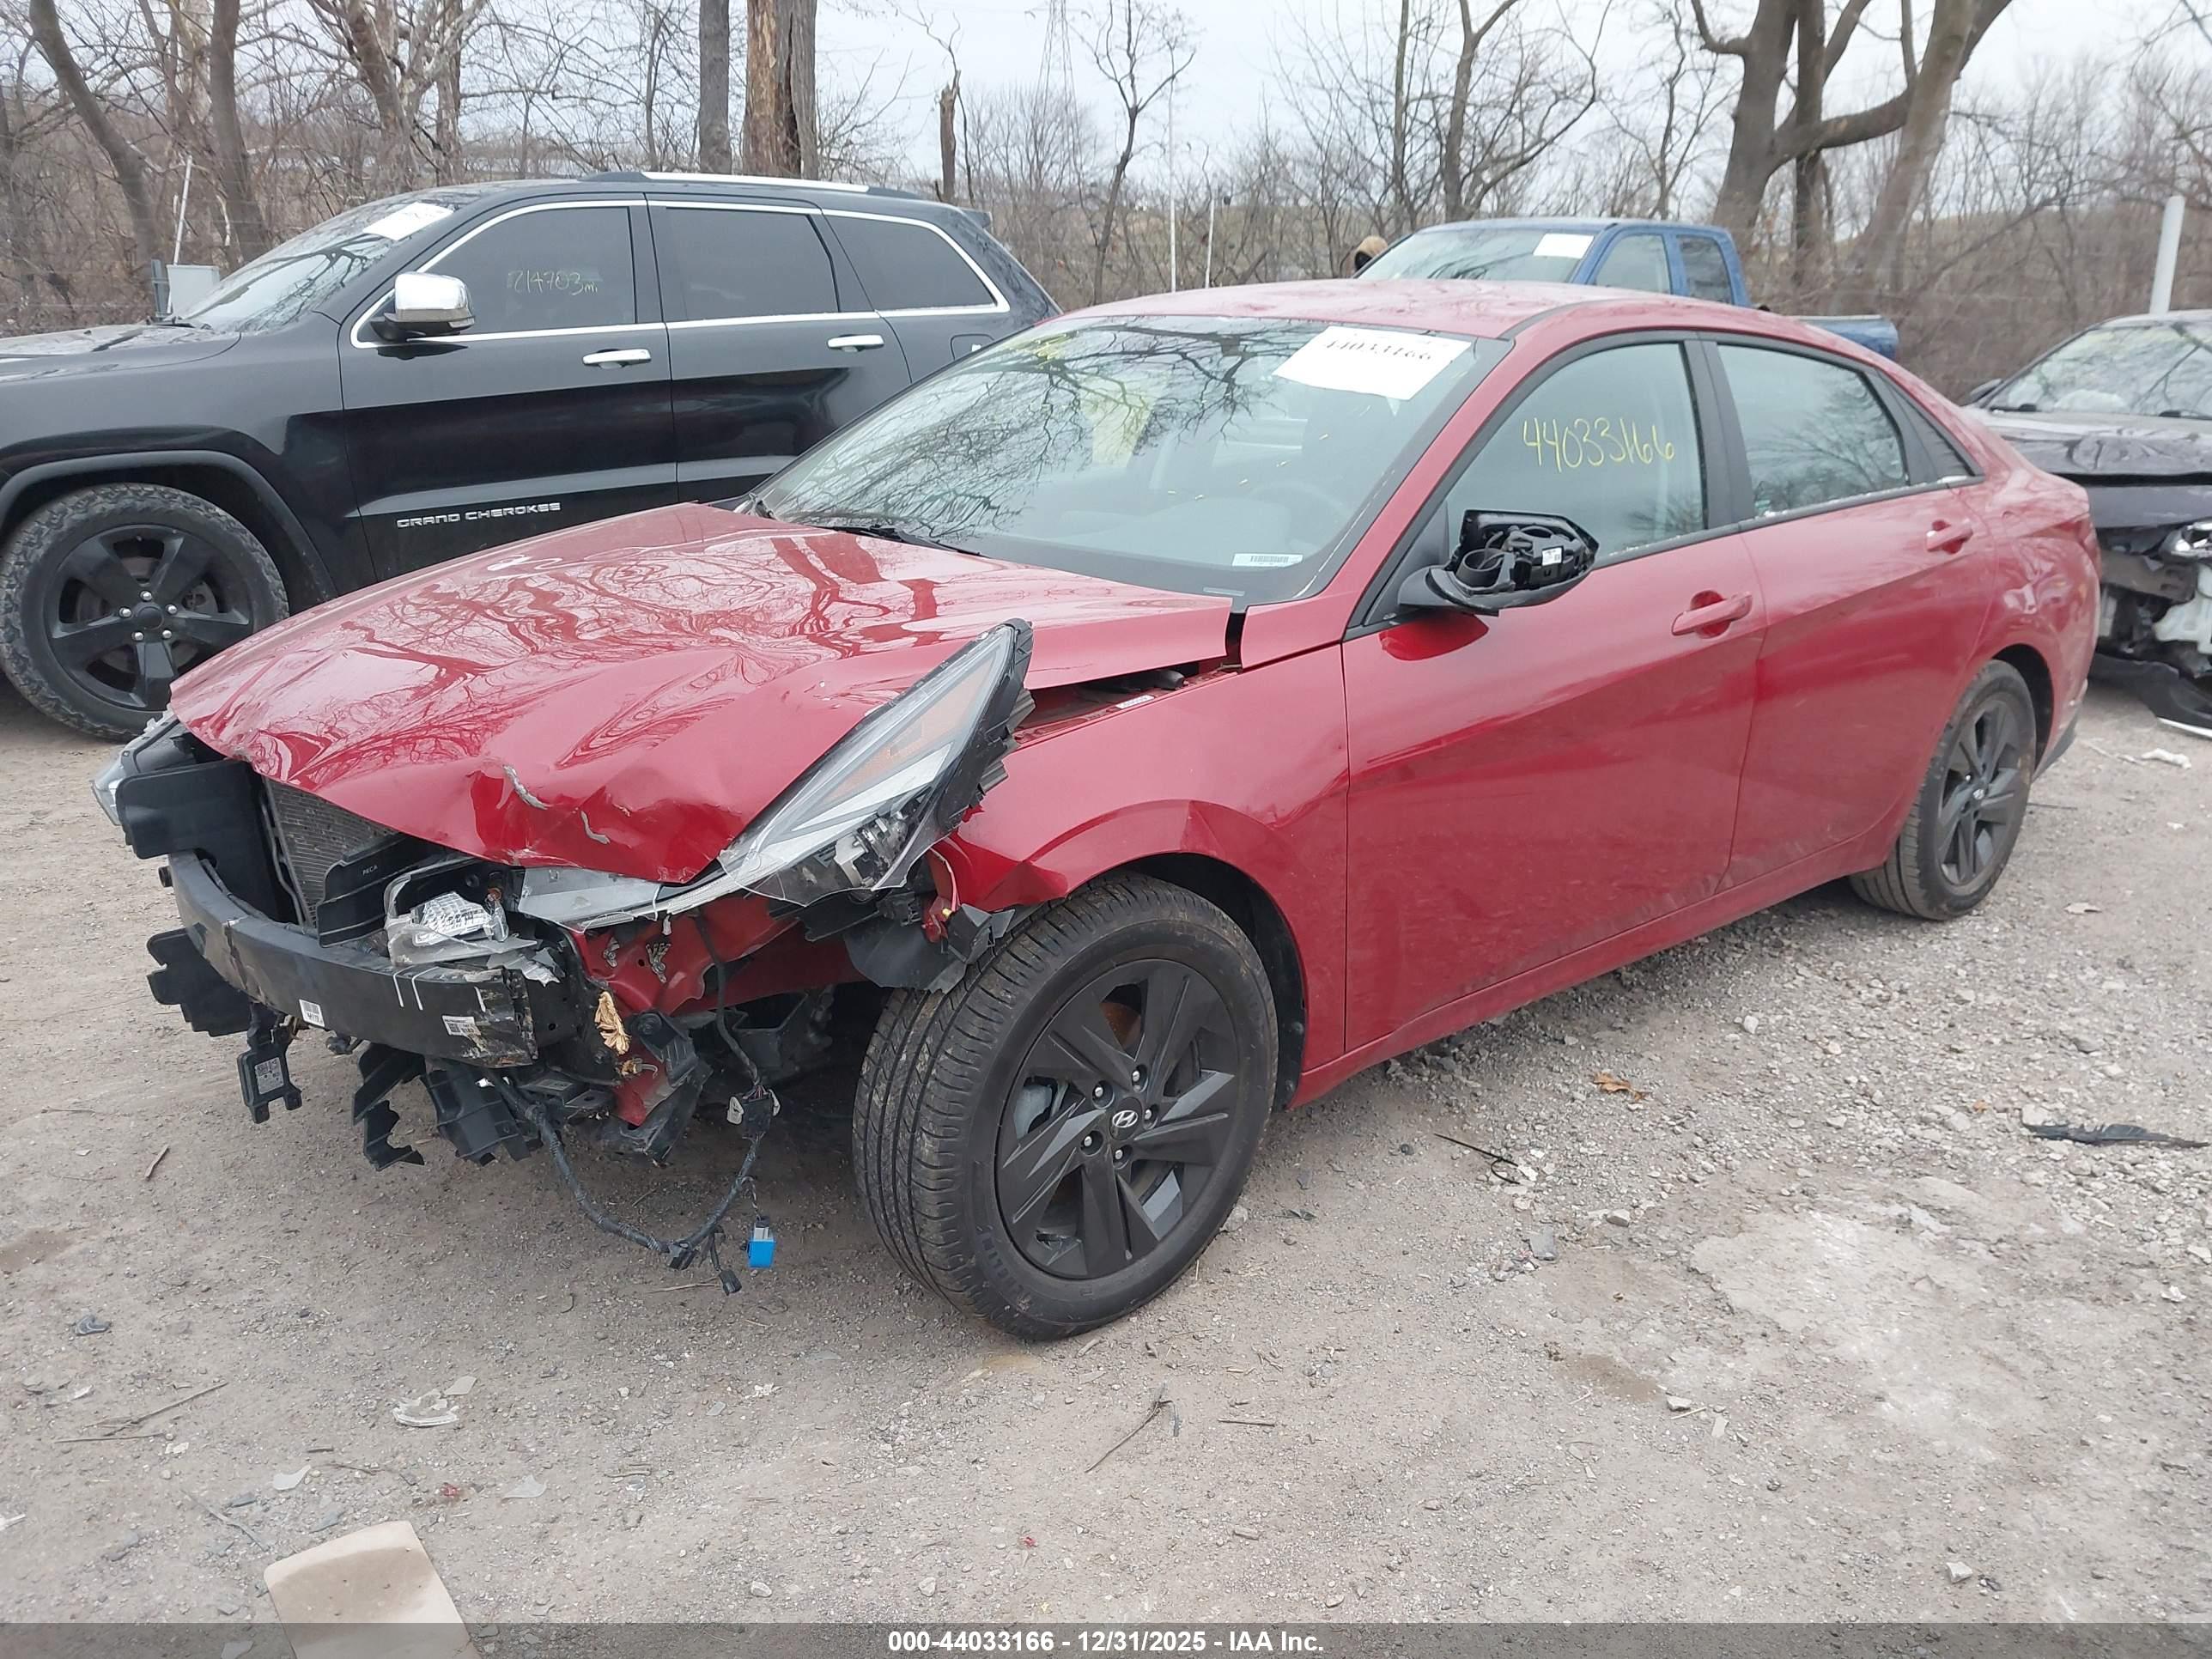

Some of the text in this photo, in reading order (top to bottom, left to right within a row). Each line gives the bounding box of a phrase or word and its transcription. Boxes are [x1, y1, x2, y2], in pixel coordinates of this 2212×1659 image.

[1522, 417, 1675, 473] 44033166
[396, 501, 562, 529] GRAND CHEROKEE
